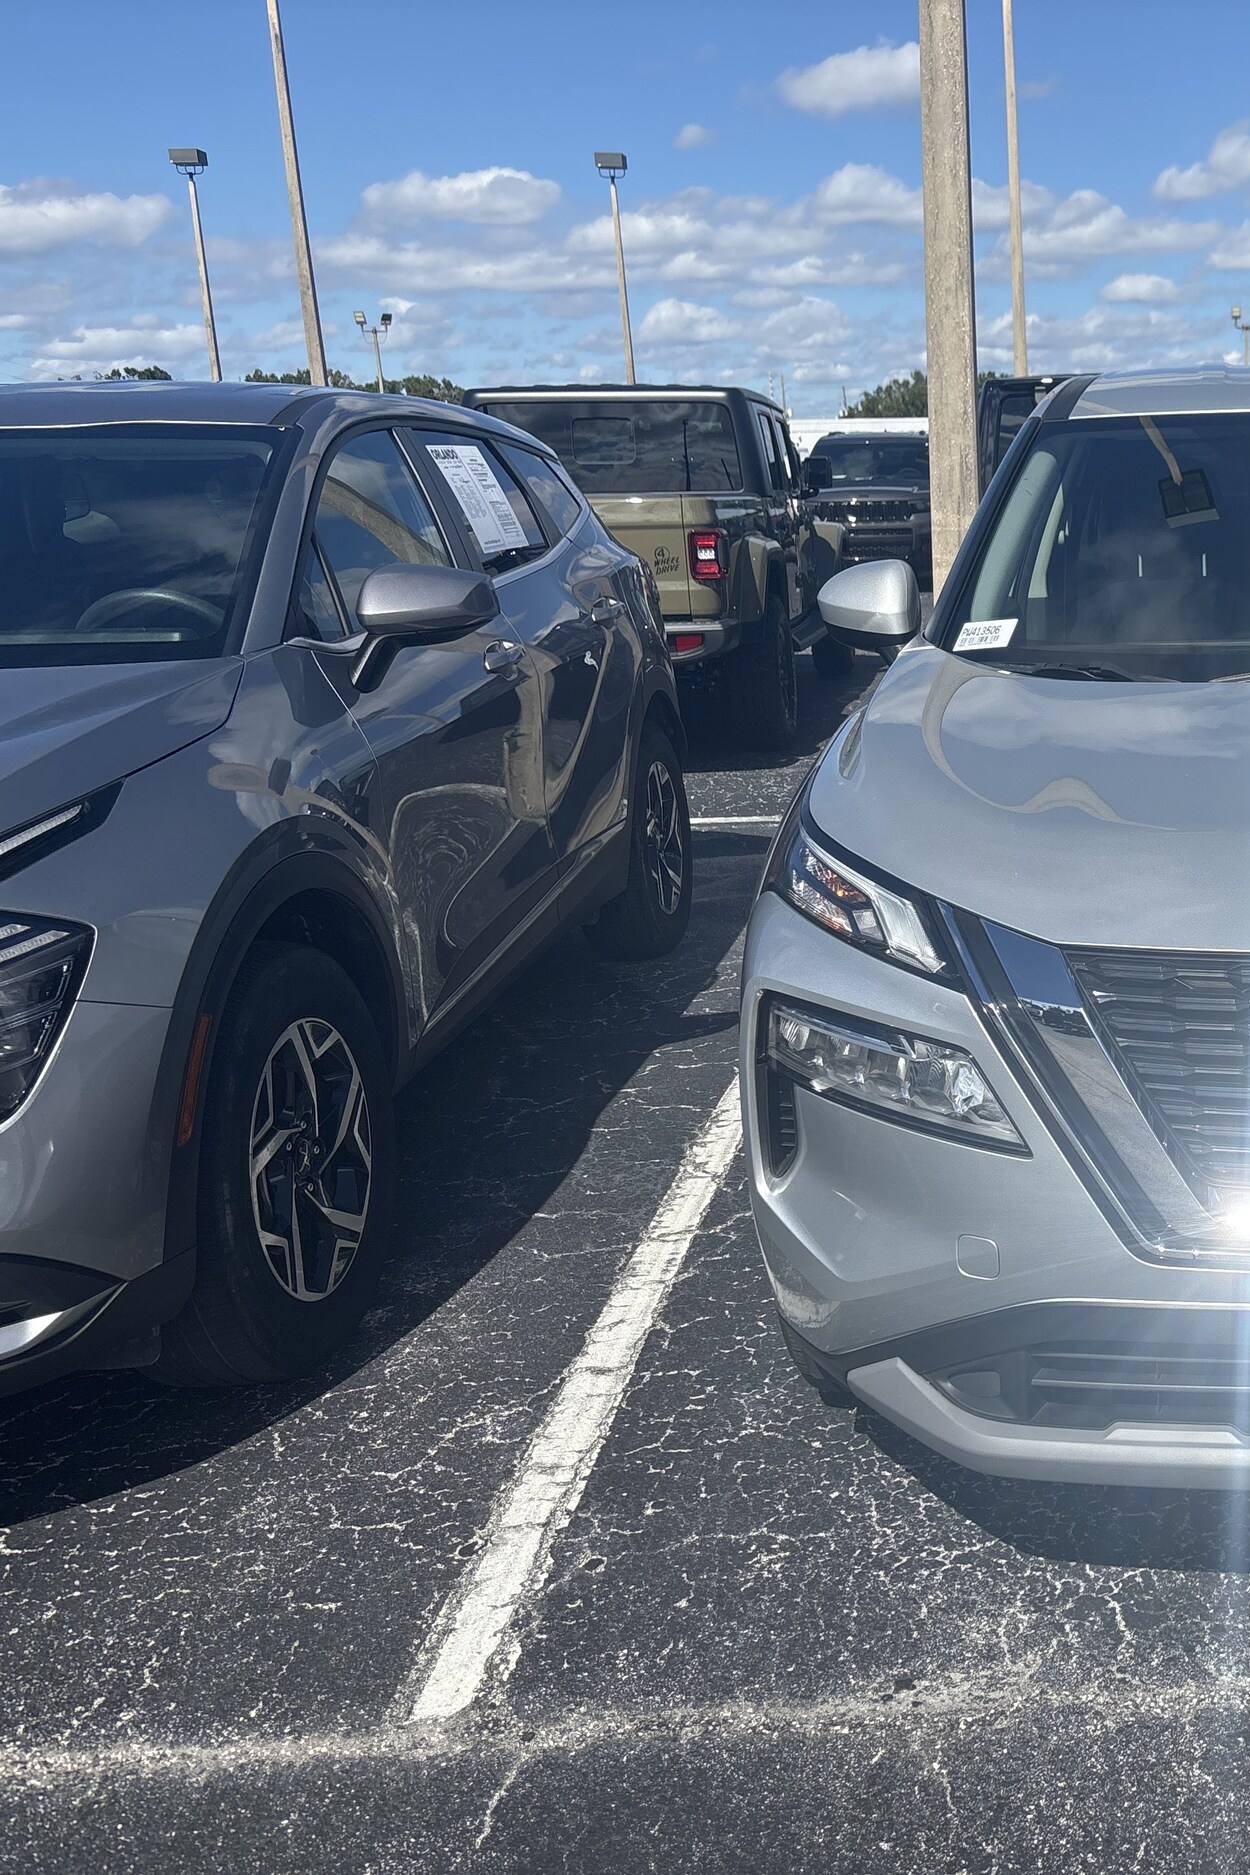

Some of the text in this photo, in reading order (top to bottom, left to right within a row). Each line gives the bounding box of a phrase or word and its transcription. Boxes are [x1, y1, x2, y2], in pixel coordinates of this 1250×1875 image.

[654, 556, 680, 567] WHEEL
[656, 563, 680, 576] DRIVE
[961, 624, 1002, 637] PW413506
